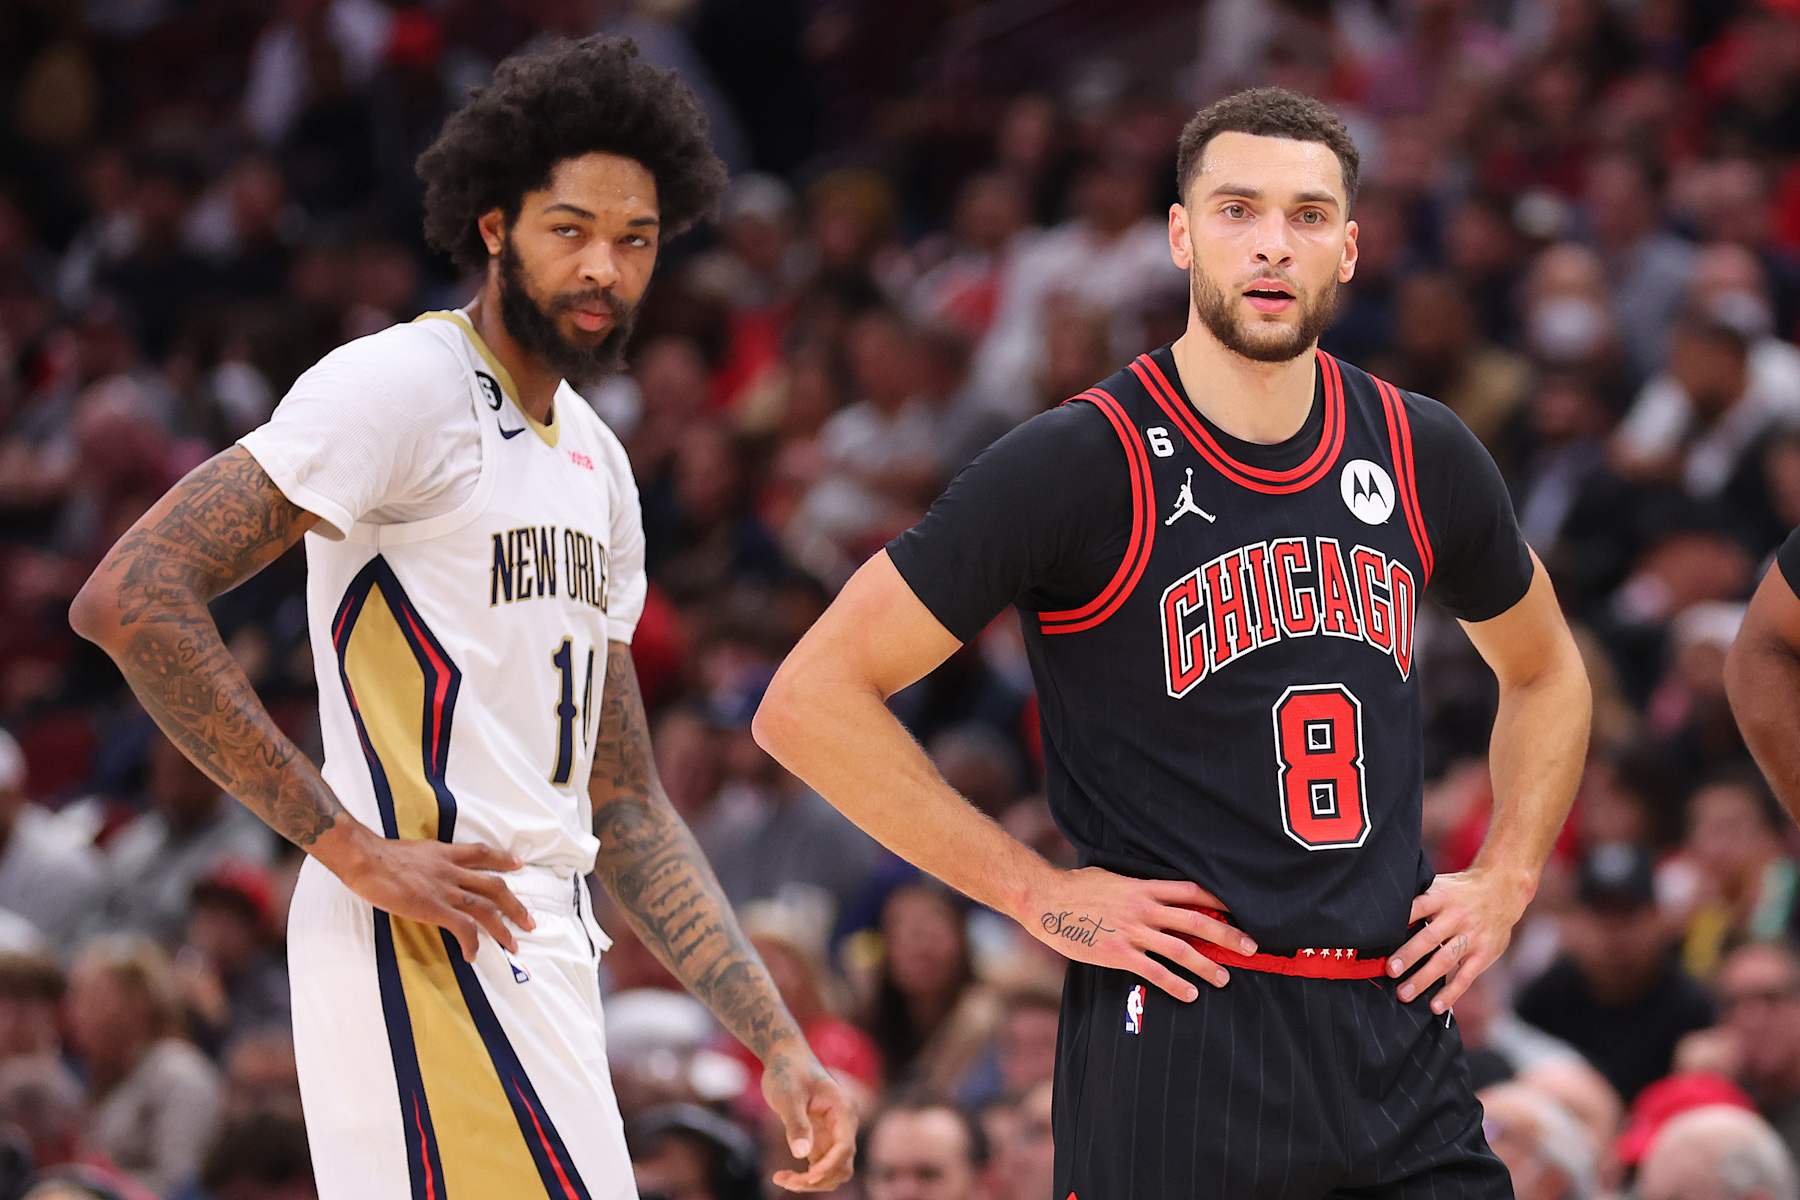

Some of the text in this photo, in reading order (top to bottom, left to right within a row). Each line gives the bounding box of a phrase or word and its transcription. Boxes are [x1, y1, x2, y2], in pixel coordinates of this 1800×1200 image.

[1147, 426, 1175, 458] 6
[489, 524, 557, 608] NEW
[1159, 536, 1416, 700] CHICAGO
[1272, 683, 1372, 852] 8
[1040, 911, 1117, 948] Saint
